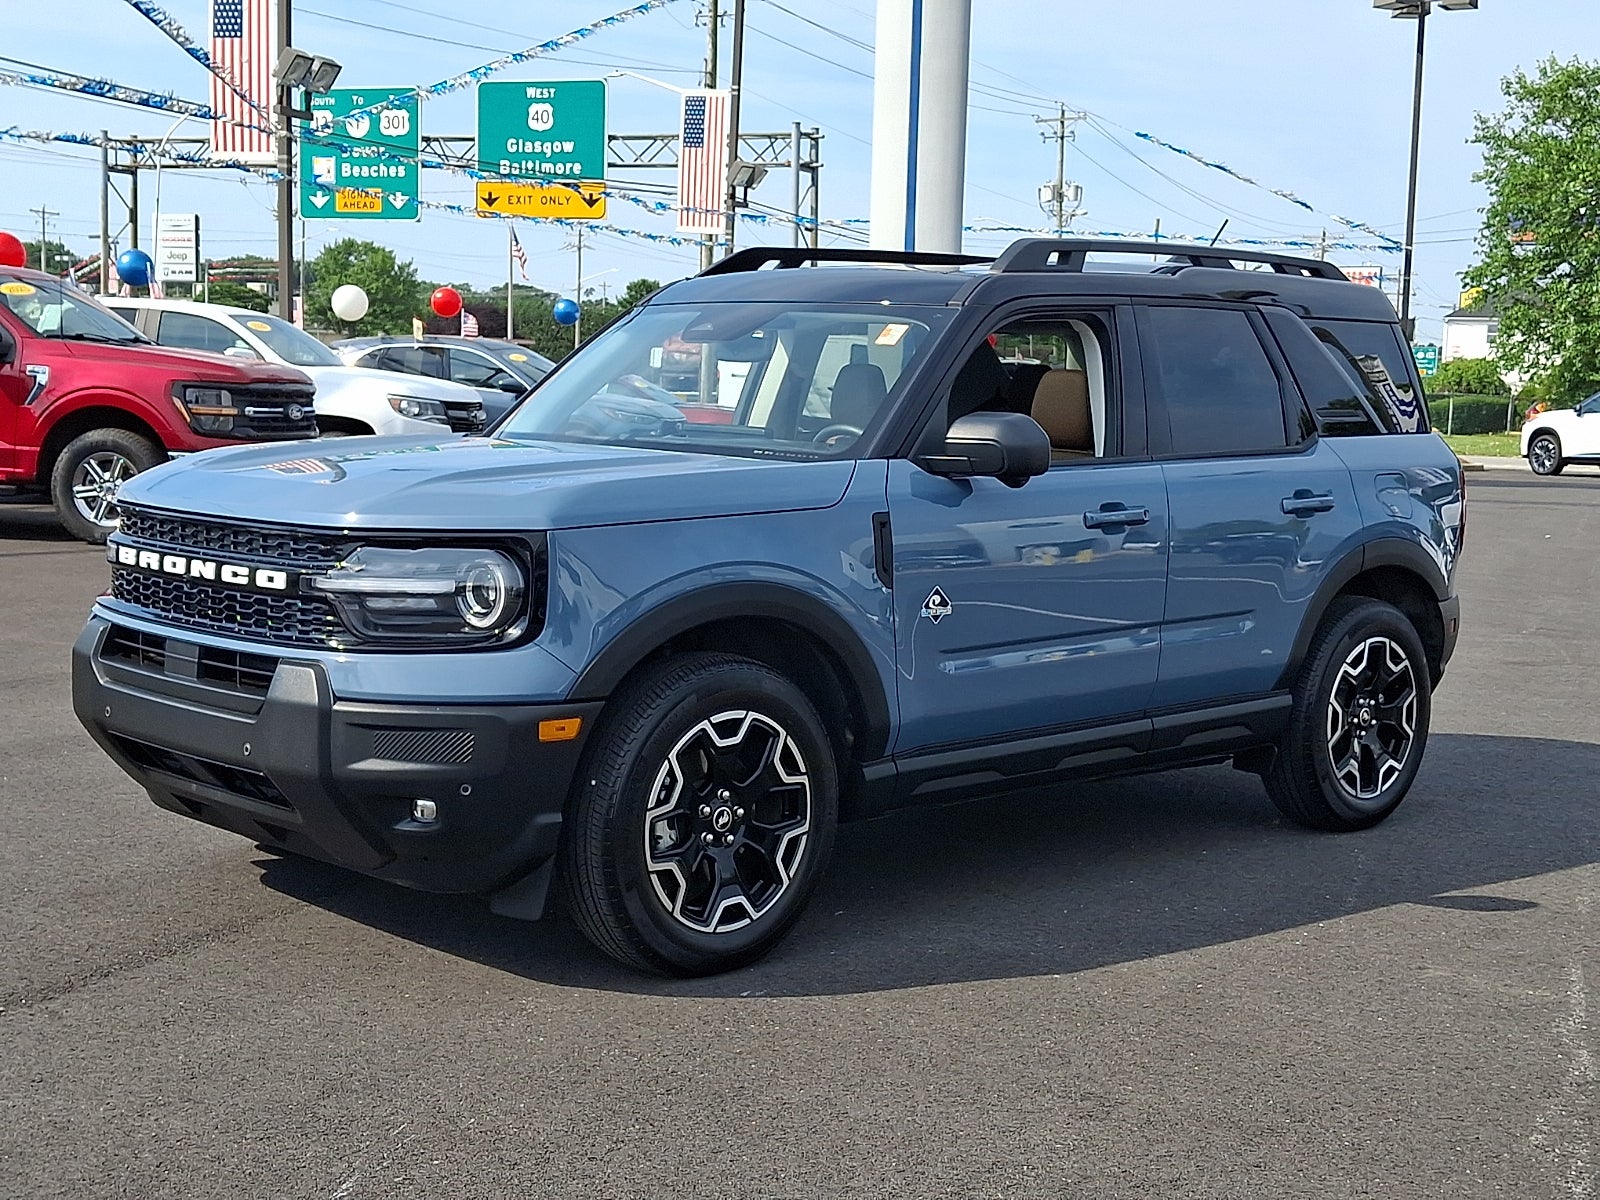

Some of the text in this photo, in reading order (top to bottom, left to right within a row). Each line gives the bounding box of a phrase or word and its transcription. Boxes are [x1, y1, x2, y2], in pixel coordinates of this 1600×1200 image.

[351, 95, 364, 105] TO
[526, 86, 556, 99] WEST
[383, 115, 405, 130] 301
[531, 109, 550, 124] 40
[506, 138, 575, 158] Glasgow
[341, 162, 406, 178] Beaches
[499, 159, 582, 175] Baltimore
[342, 201, 375, 209] AHEAD
[507, 195, 572, 206] EXIT ONLY
[167, 250, 188, 261] Jeep
[118, 545, 287, 590] BRONCO
